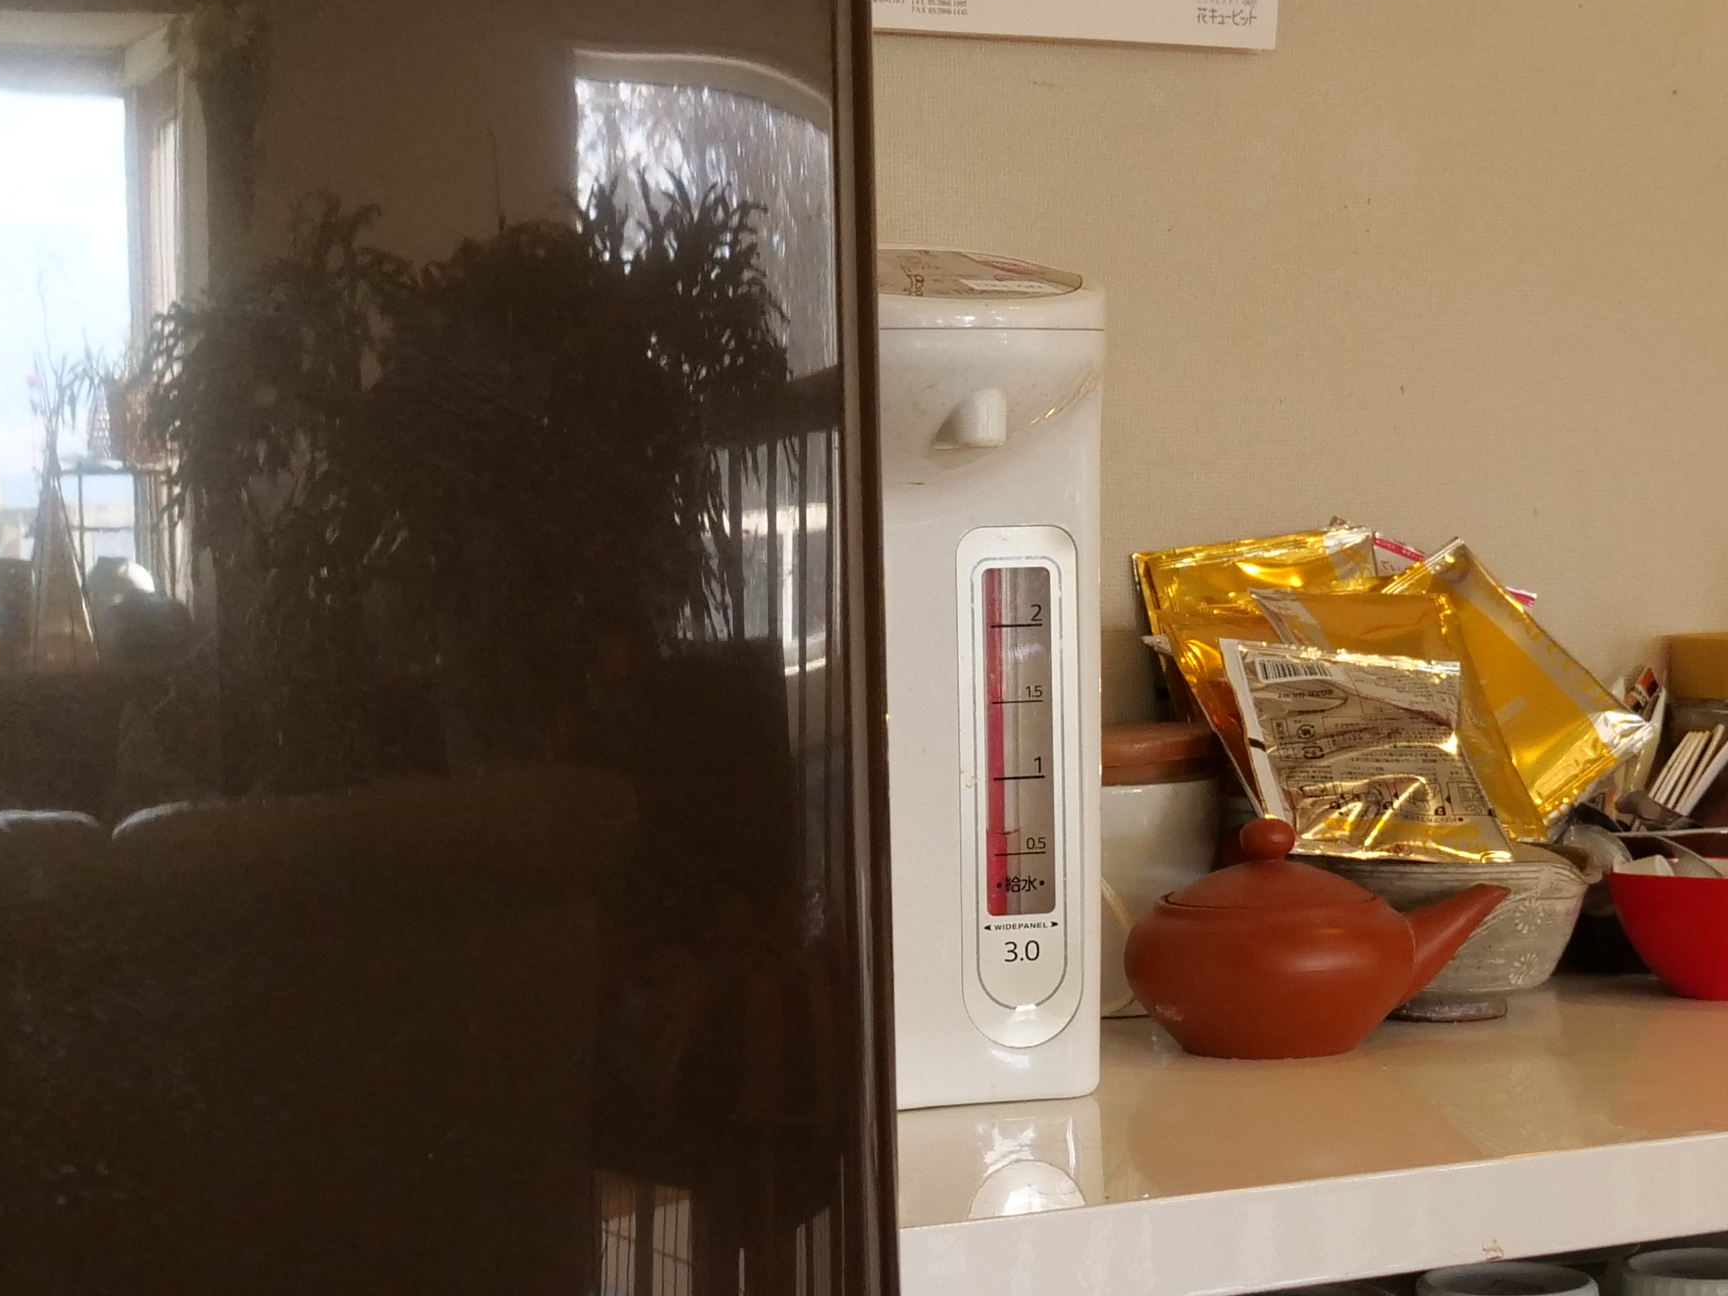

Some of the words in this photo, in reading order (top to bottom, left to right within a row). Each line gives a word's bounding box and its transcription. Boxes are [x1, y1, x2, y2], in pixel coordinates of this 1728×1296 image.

[1030, 604, 1042, 622] 2
[1025, 685, 1043, 698] 1.5
[1033, 756, 1042, 774] 1
[1025, 837, 1047, 851] 0.5
[1005, 876, 1037, 893] 給水
[994, 922, 1048, 932] WIDEPANEL
[1003, 940, 1041, 964] 3.0
